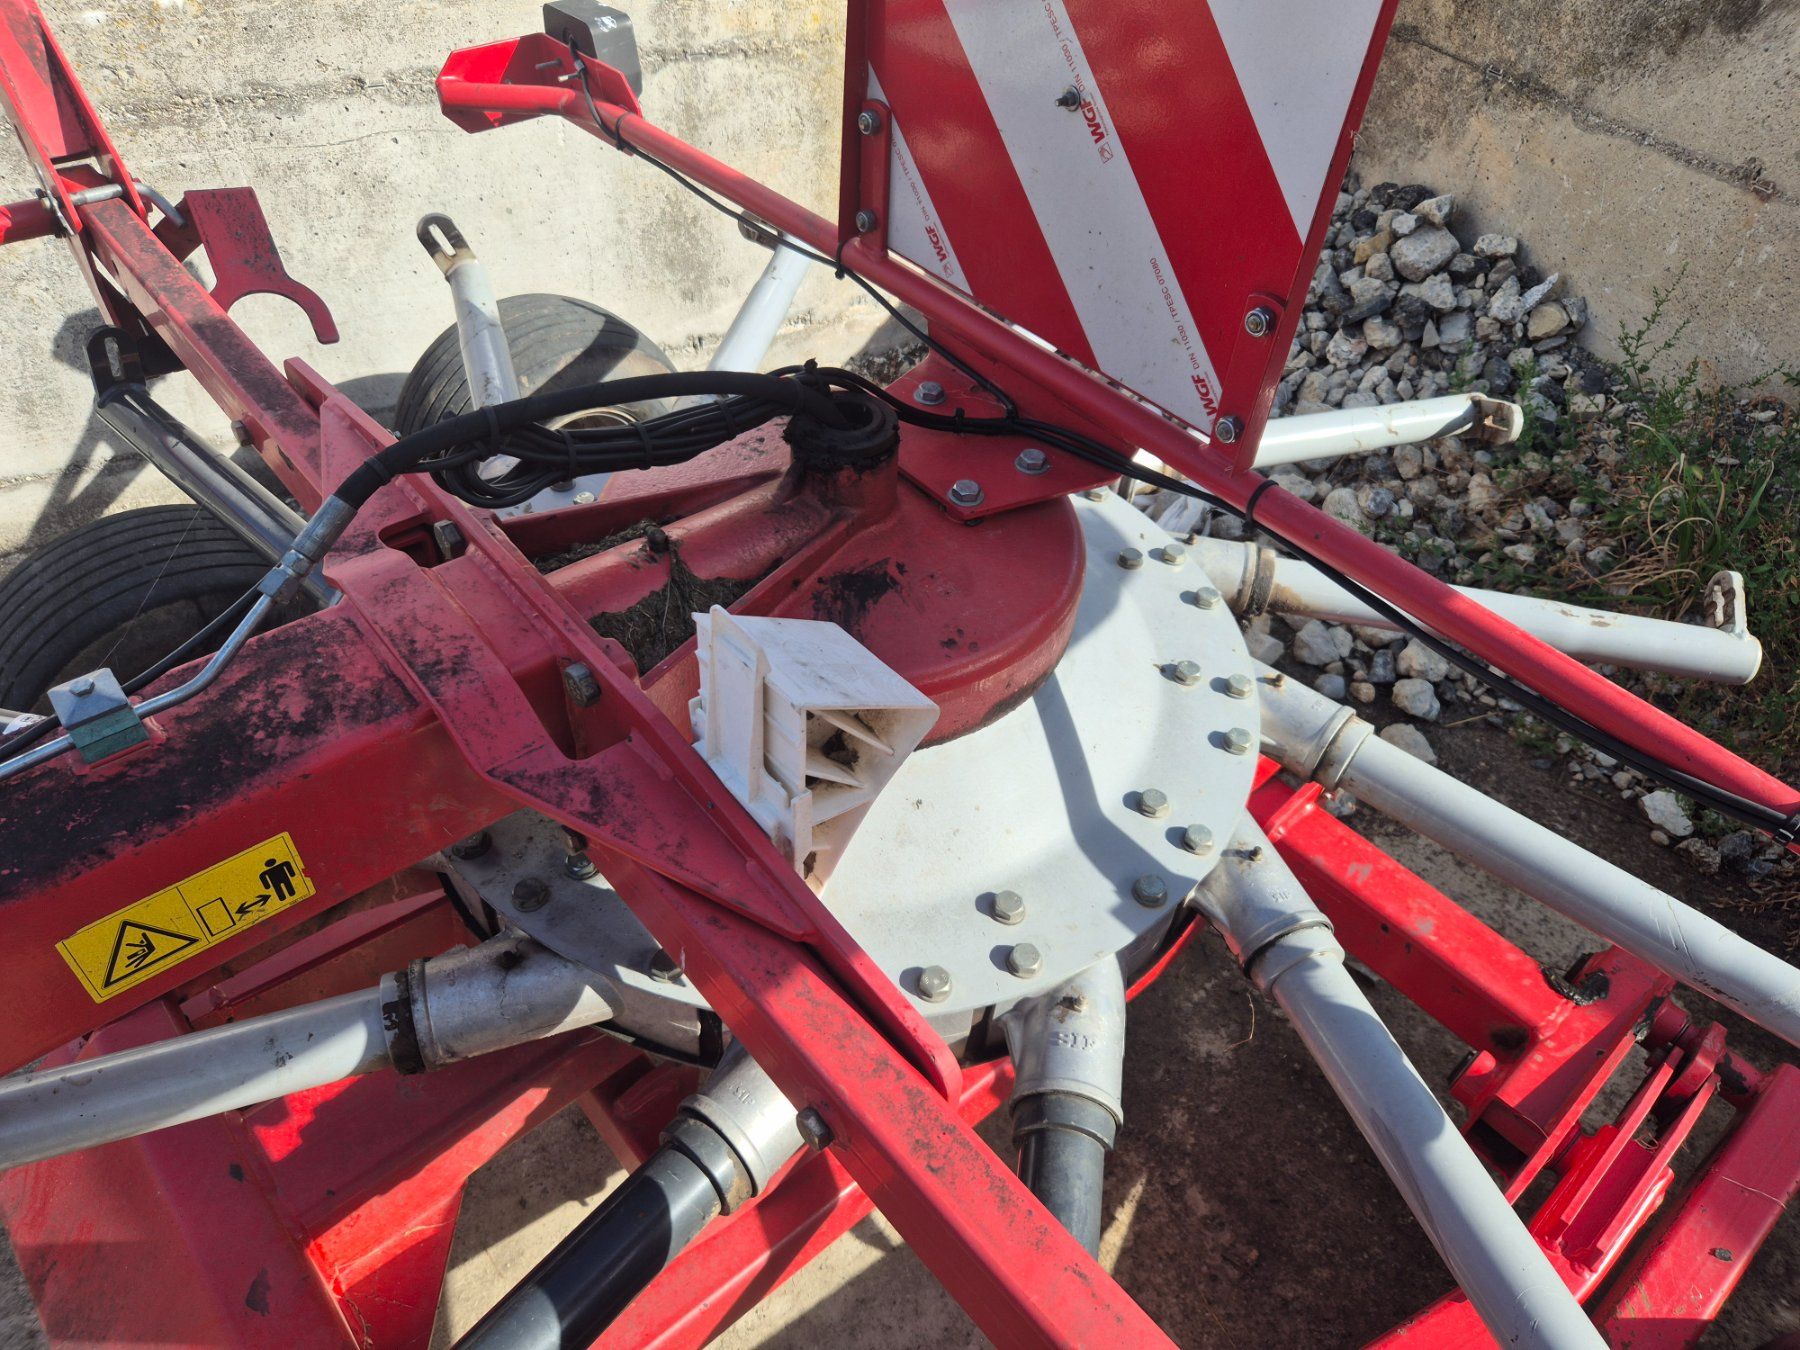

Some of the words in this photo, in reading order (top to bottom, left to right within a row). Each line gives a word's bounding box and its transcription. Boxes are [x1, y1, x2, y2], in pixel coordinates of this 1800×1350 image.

[1044, 2, 1062, 38] TPESC
[1062, 44, 1077, 72] 11030
[1074, 74, 1086, 92] DIN
[1080, 98, 1106, 144] WGF
[925, 225, 948, 262] WGF
[1149, 257, 1165, 285] 07080
[1161, 286, 1178, 319] TPESC
[1177, 325, 1192, 350] 11030
[1188, 352, 1200, 370] DIN
[1191, 374, 1218, 416] WGF
